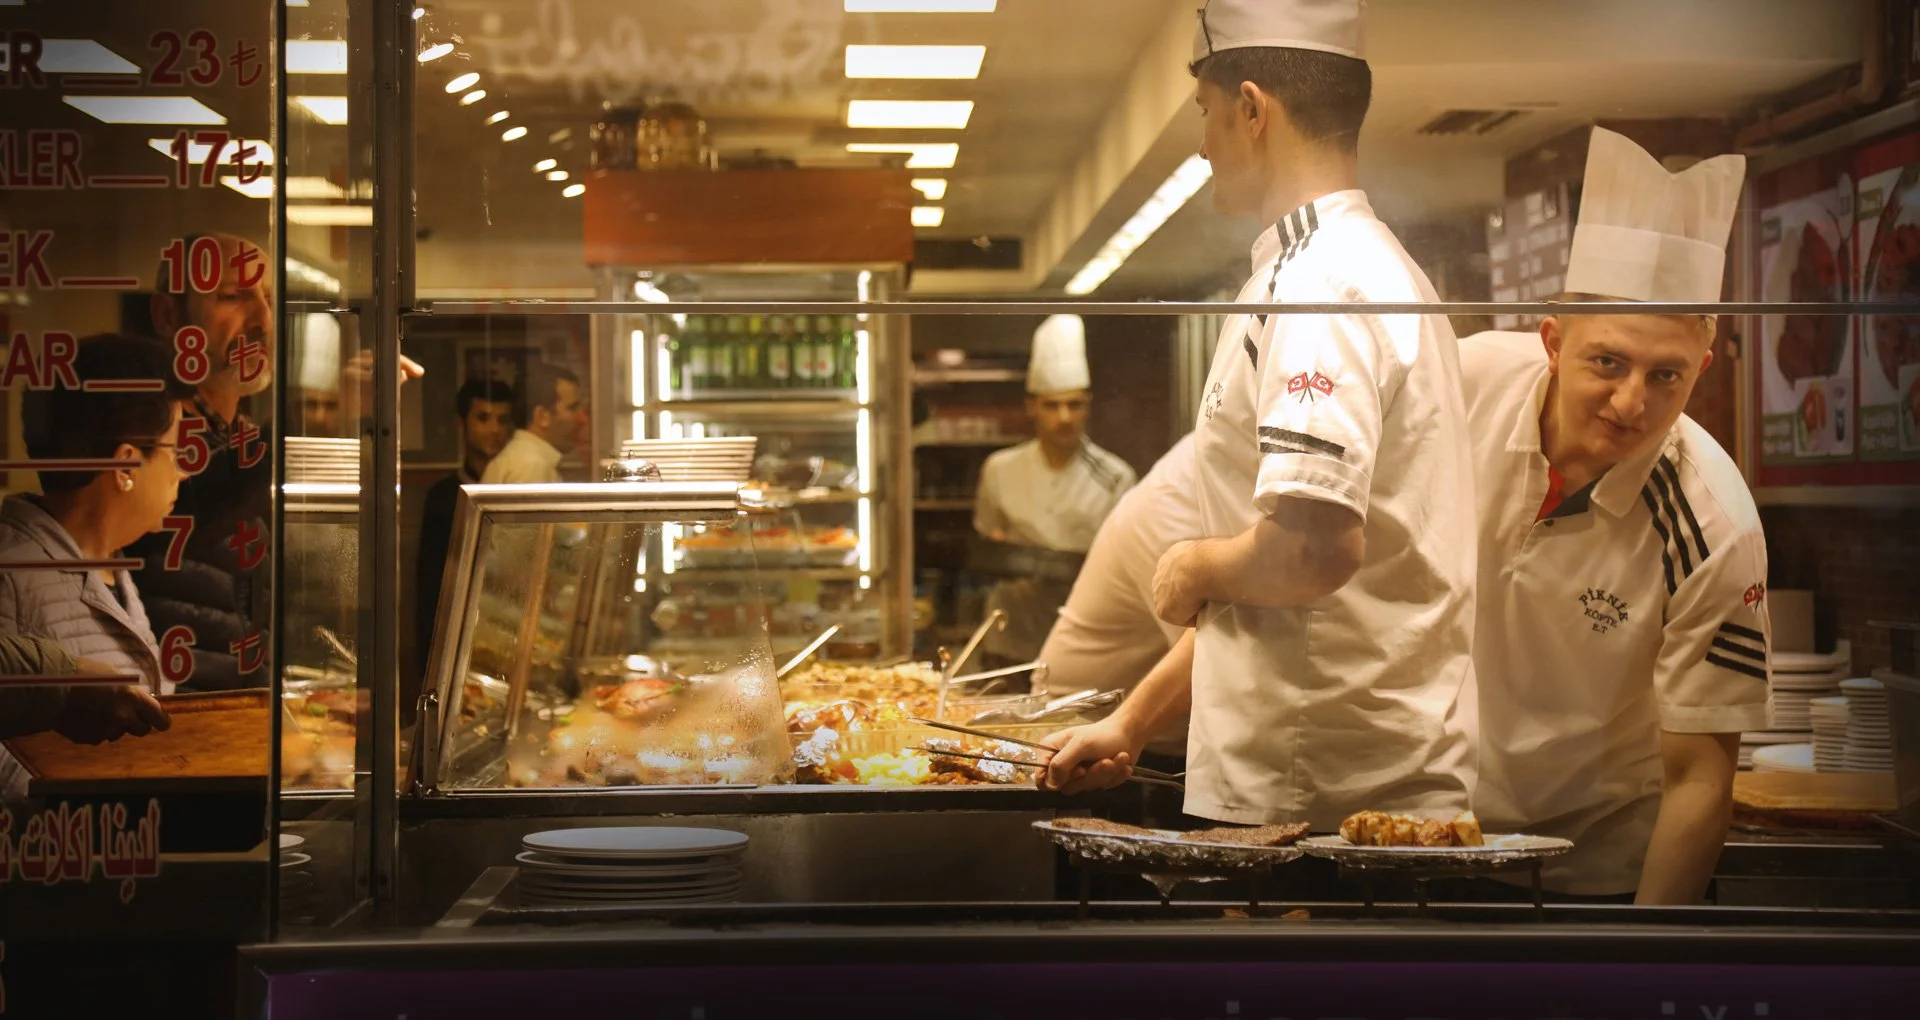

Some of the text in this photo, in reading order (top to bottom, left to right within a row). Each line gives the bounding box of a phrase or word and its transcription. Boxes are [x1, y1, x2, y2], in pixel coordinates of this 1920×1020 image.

[0, 31, 46, 87] R
[149, 29, 221, 87] 23
[0, 130, 83, 189] LER
[169, 130, 230, 188] 17
[161, 237, 222, 293] 10
[174, 326, 208, 384] 8
[175, 417, 210, 475] 5
[161, 516, 194, 570] 7
[159, 625, 195, 683] 6
